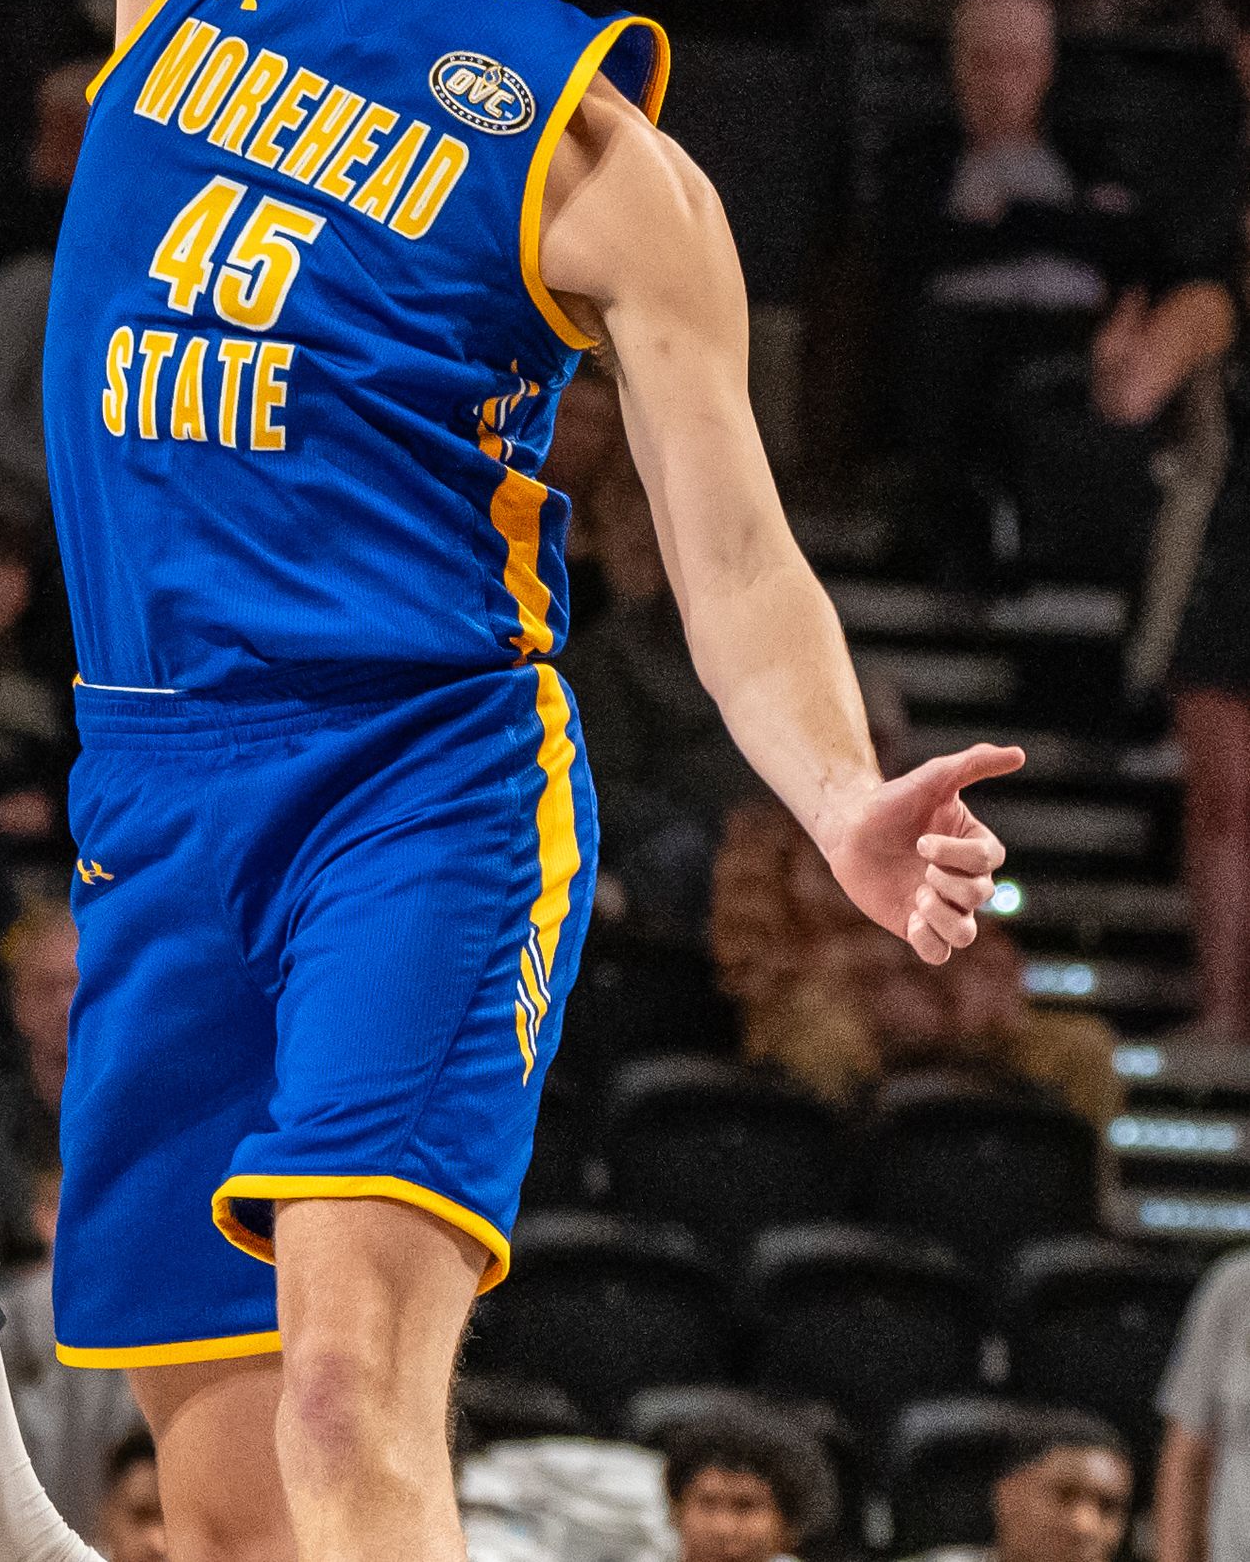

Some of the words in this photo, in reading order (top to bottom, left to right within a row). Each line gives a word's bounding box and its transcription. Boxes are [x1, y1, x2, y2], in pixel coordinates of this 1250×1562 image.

[133, 17, 470, 240] MOREHEAD
[446, 67, 516, 119] OVC
[148, 174, 327, 332] 45
[102, 325, 296, 452] STATE
